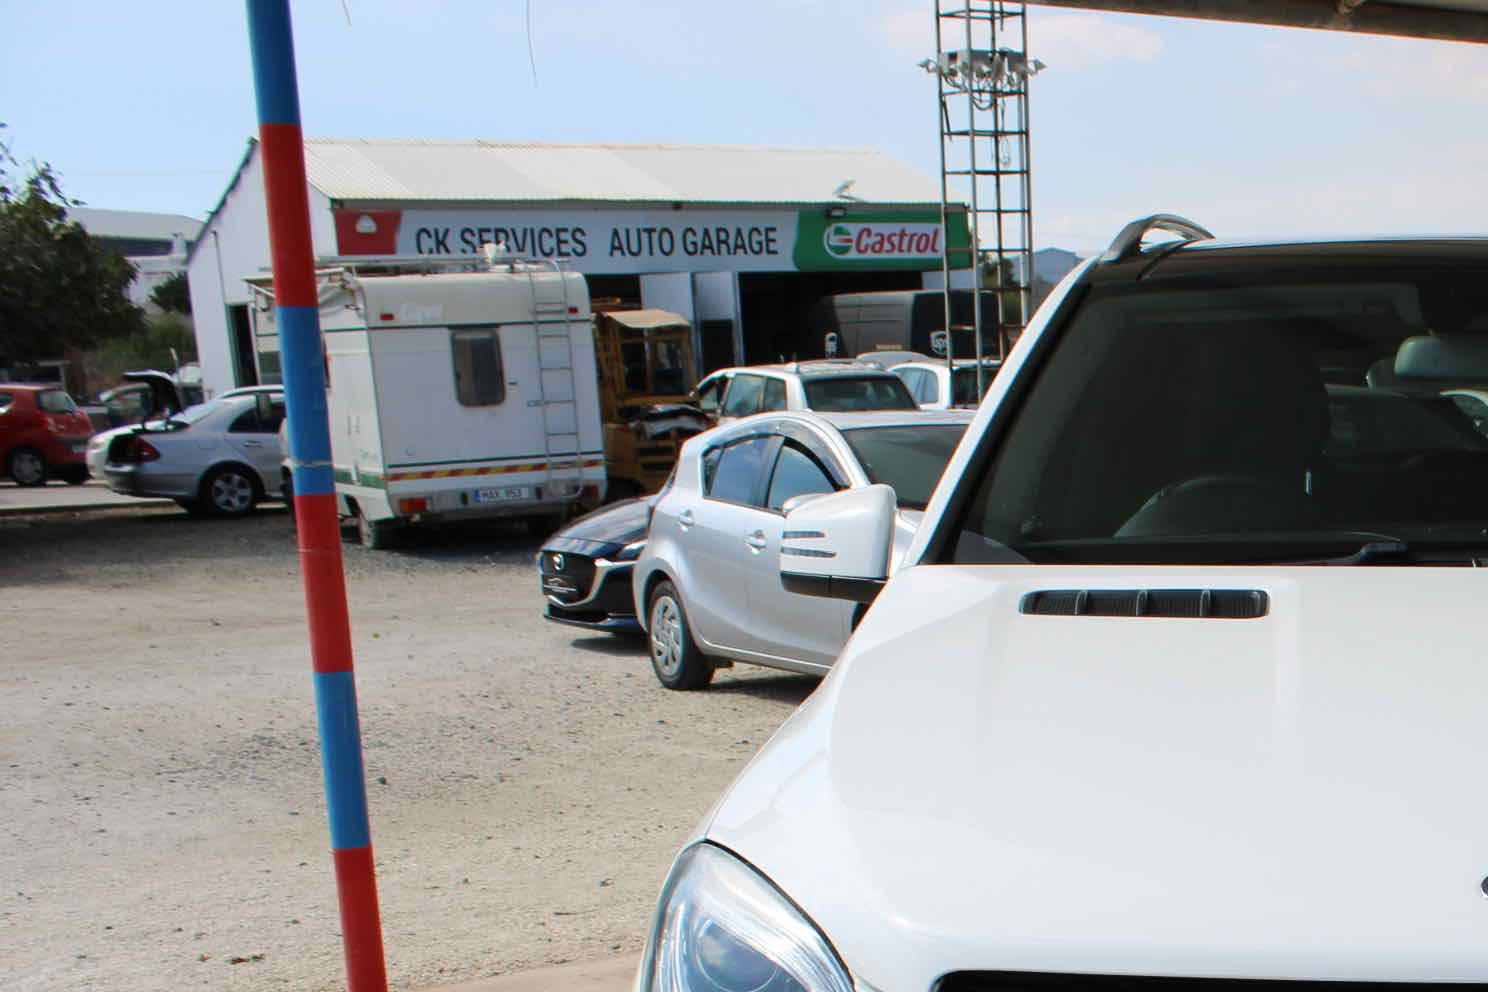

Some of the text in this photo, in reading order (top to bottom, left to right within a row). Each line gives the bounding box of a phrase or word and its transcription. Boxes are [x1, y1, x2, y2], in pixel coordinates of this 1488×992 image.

[415, 227, 588, 257] CK SERVICES
[609, 227, 779, 257] AUTO GARAGE
[855, 226, 939, 255] Castrol
